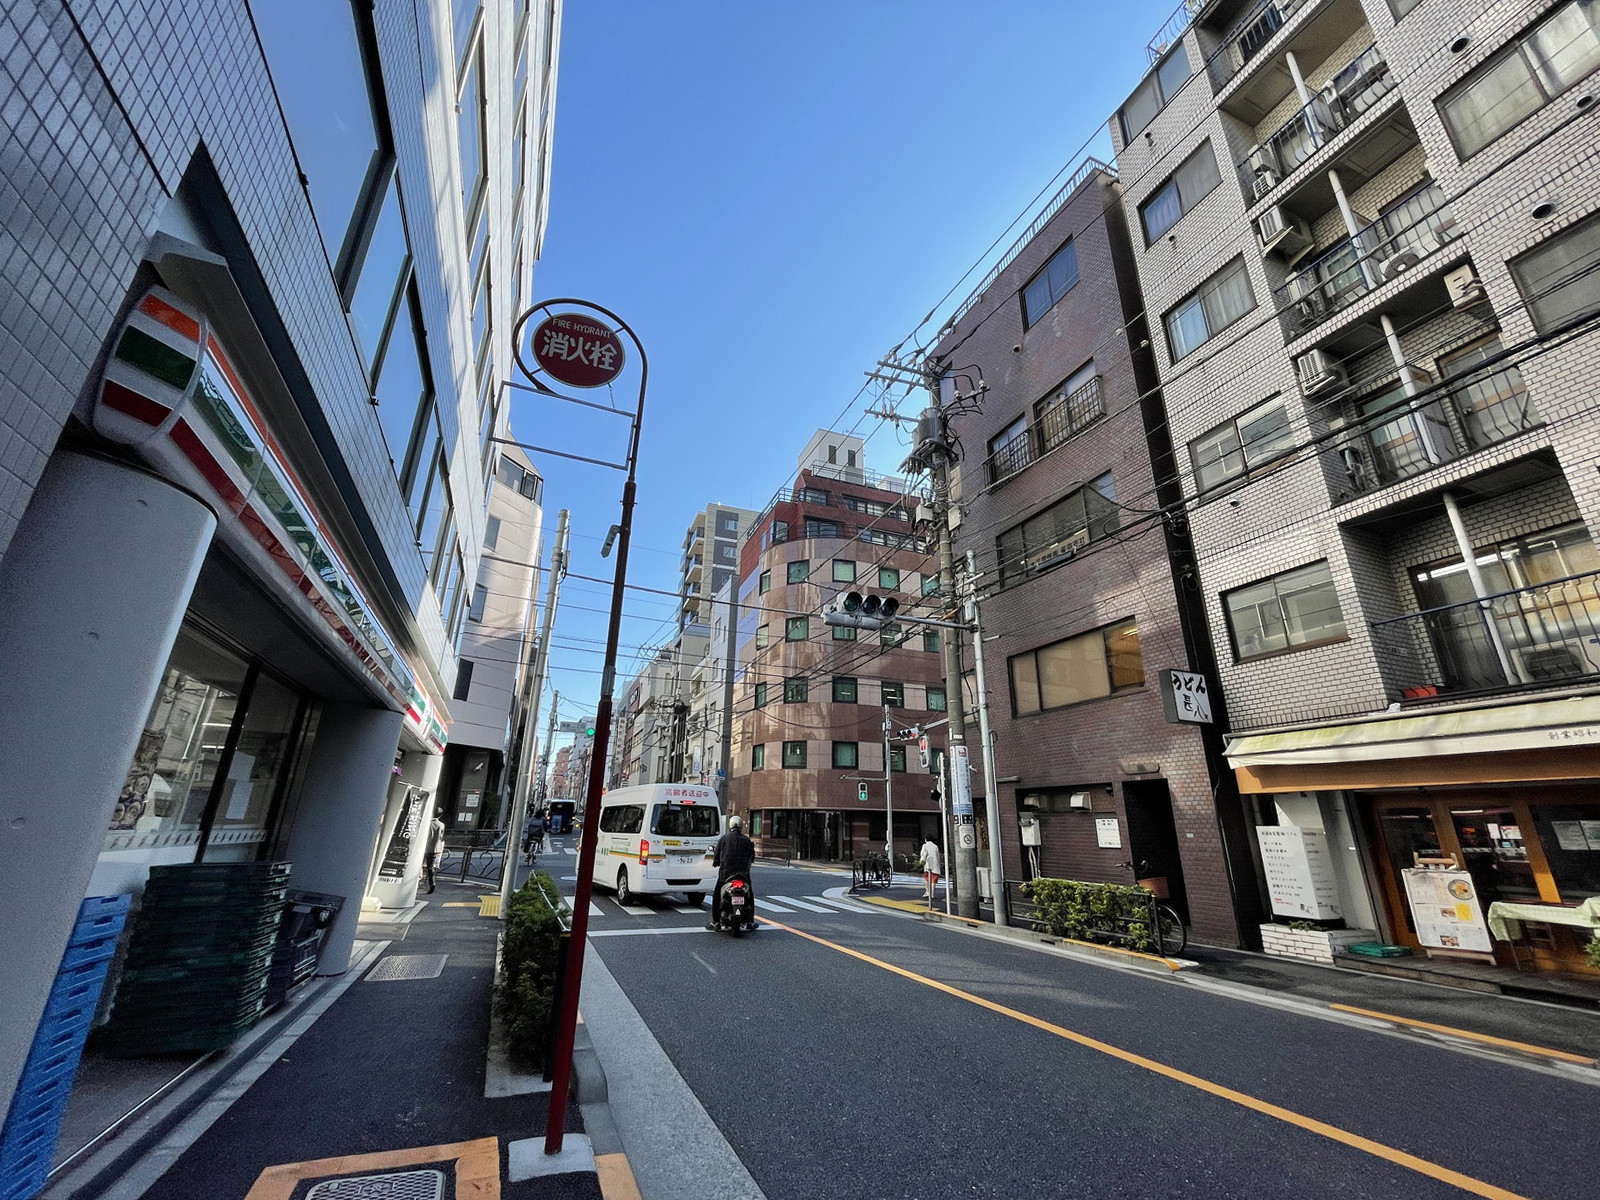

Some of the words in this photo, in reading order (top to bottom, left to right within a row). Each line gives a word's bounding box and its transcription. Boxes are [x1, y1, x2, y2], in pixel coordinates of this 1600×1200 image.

[552, 318, 571, 330] FIRE
[573, 322, 611, 338] HYDRANT
[540, 329, 617, 371] 消火栓
